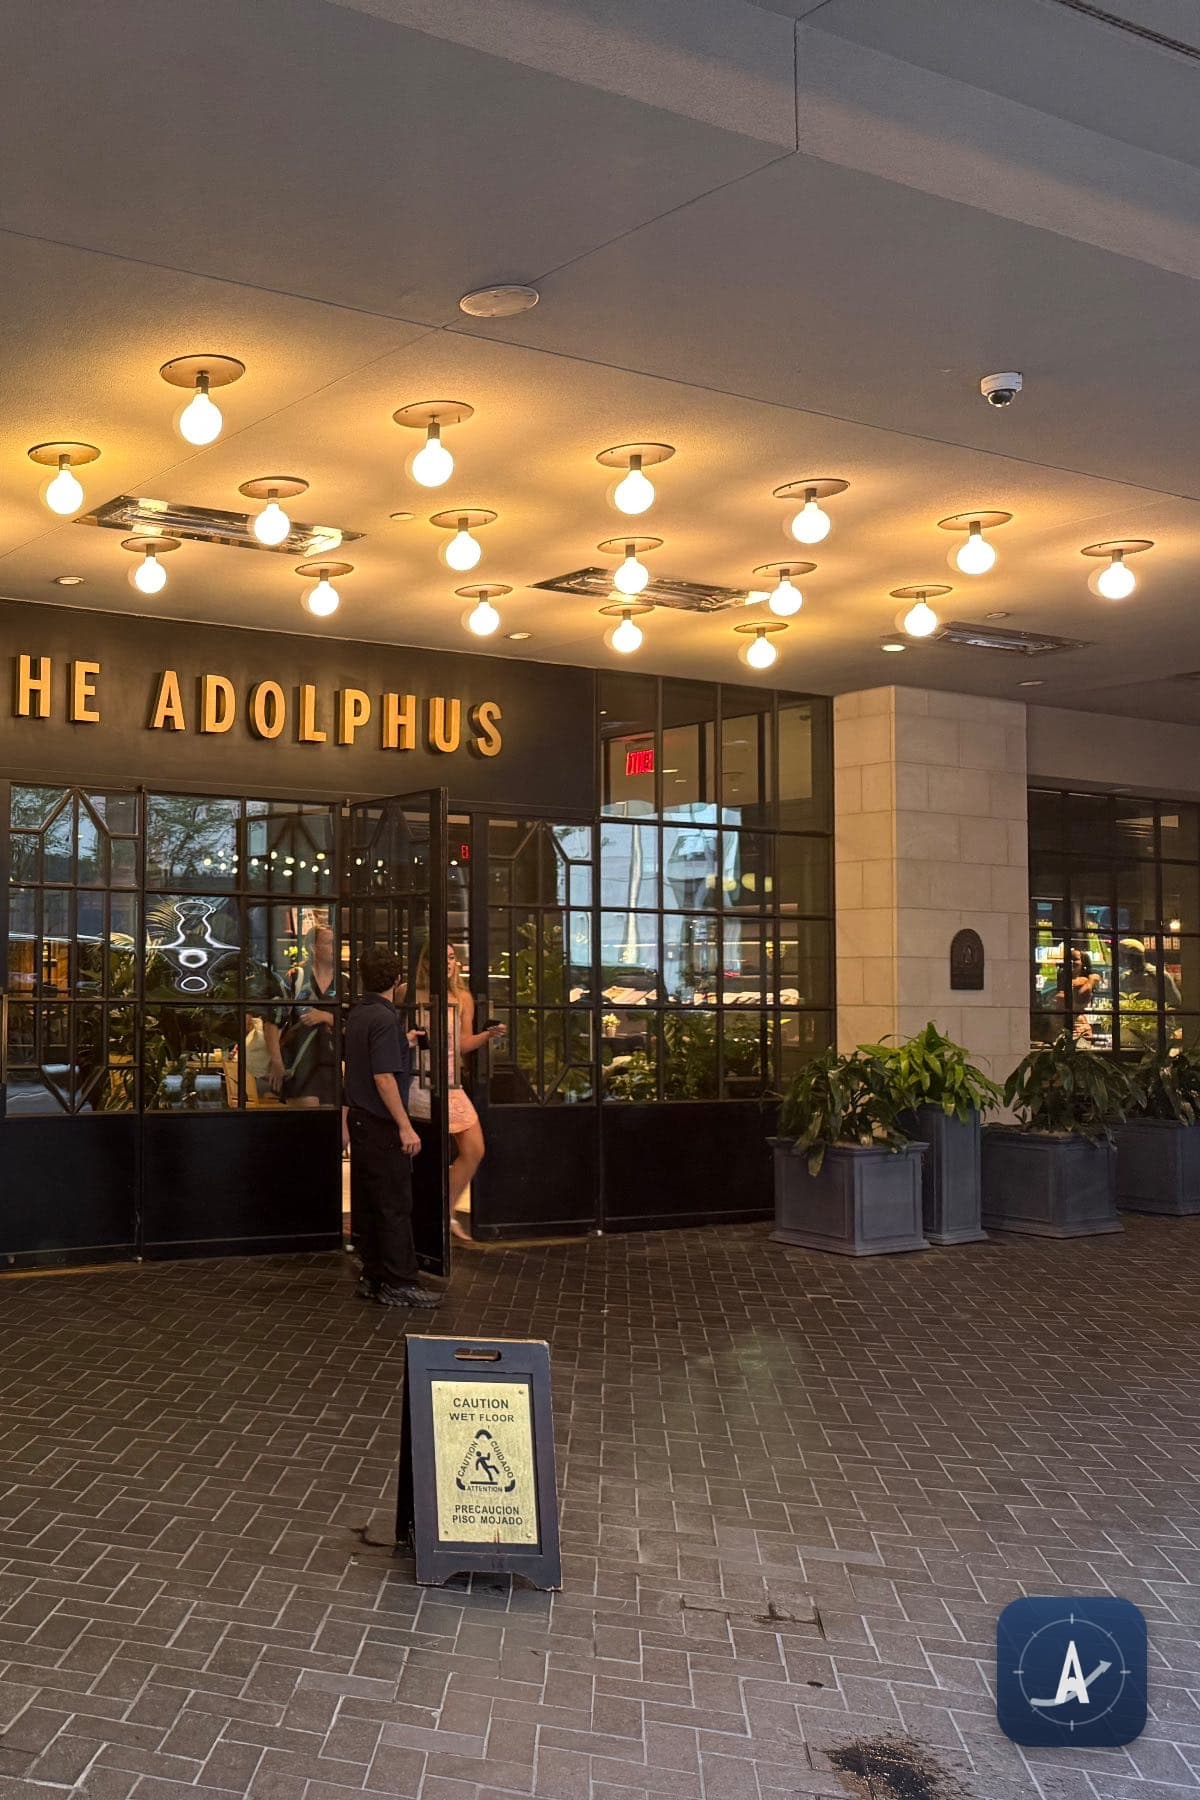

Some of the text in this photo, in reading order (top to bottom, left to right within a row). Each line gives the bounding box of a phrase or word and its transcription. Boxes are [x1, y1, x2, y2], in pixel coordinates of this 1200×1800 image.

[150, 670, 503, 758] ADOLPHUS
[452, 1397, 509, 1409] CAUTION
[449, 1412, 515, 1422] WET FLOOR
[457, 1440, 479, 1478] CAUTION
[490, 1440, 514, 1479] CUIDADO
[466, 1485, 503, 1493] ATTENTION
[454, 1504, 520, 1515] PRECAUCION
[452, 1514, 523, 1526] PISO MOJADO
